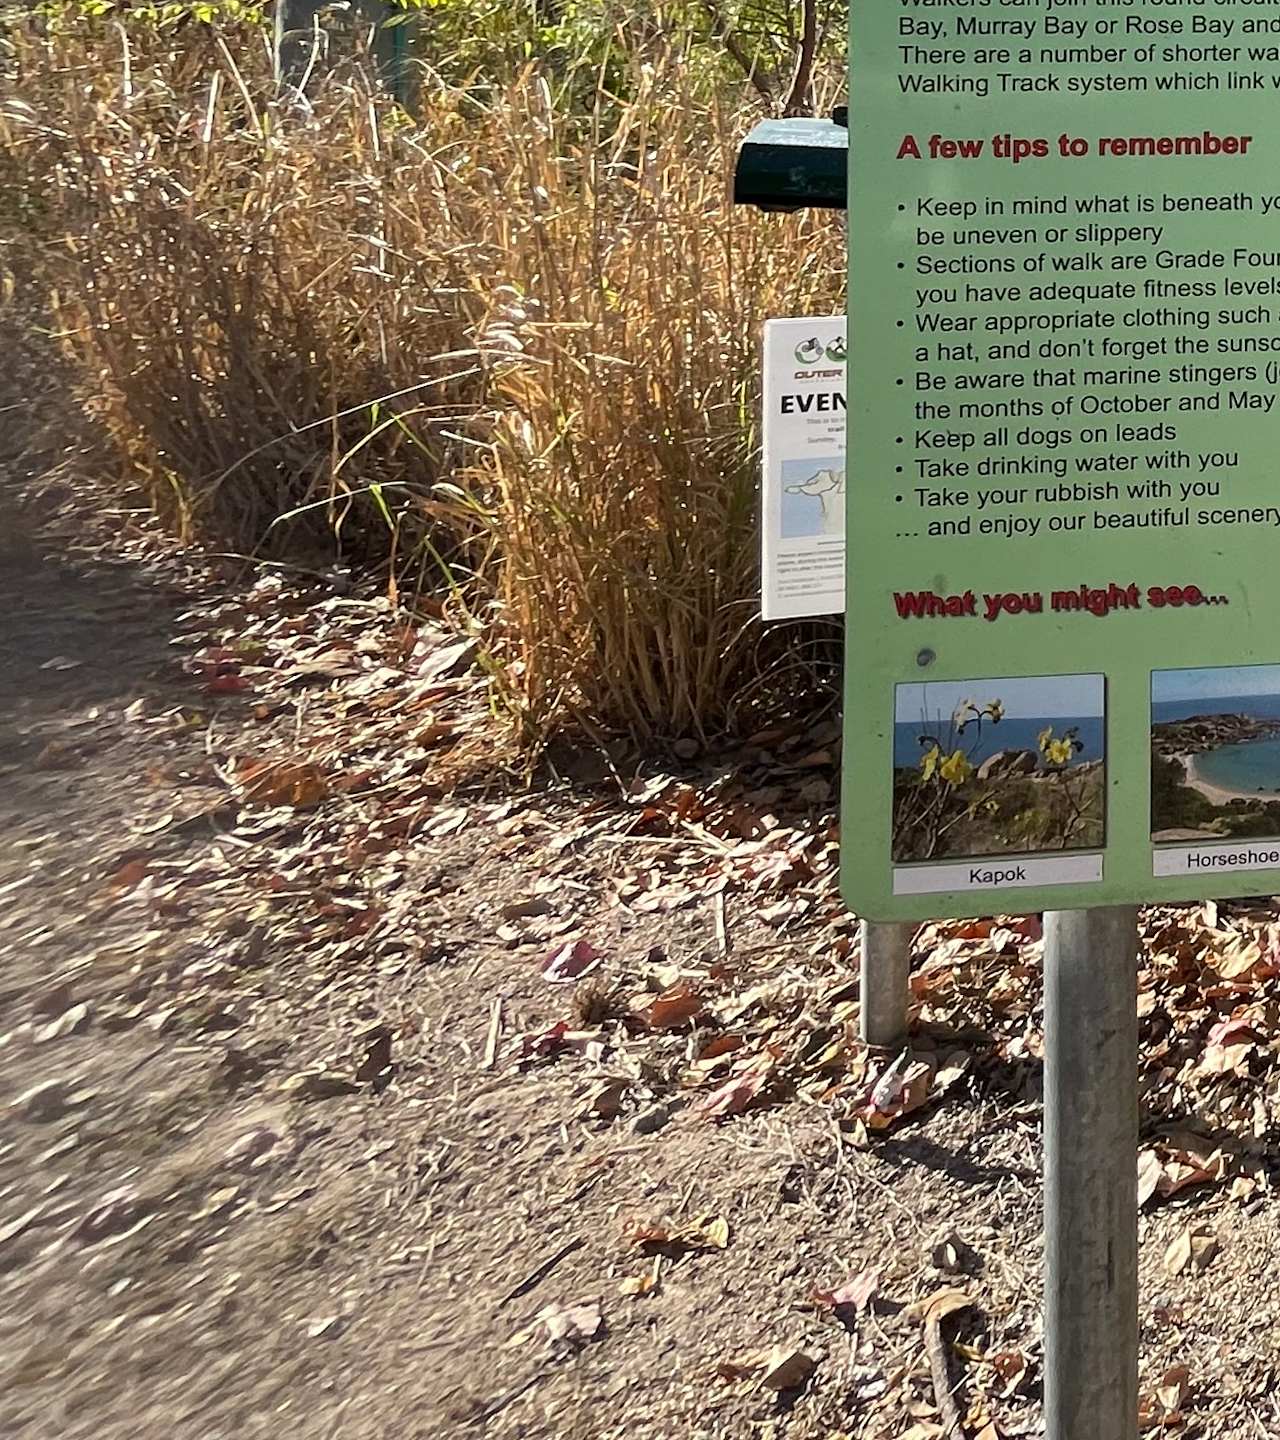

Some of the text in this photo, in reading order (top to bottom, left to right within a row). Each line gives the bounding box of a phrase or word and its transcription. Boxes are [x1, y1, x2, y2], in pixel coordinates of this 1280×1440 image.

[897, 131, 1252, 163] A few tips to remember
[781, 393, 847, 414] EVEN
[916, 422, 1176, 452] Keep all dogs on leads
[893, 582, 1229, 622] What you might see...
[1188, 850, 1279, 868] Horseshoe
[969, 866, 1026, 884] Kapok
